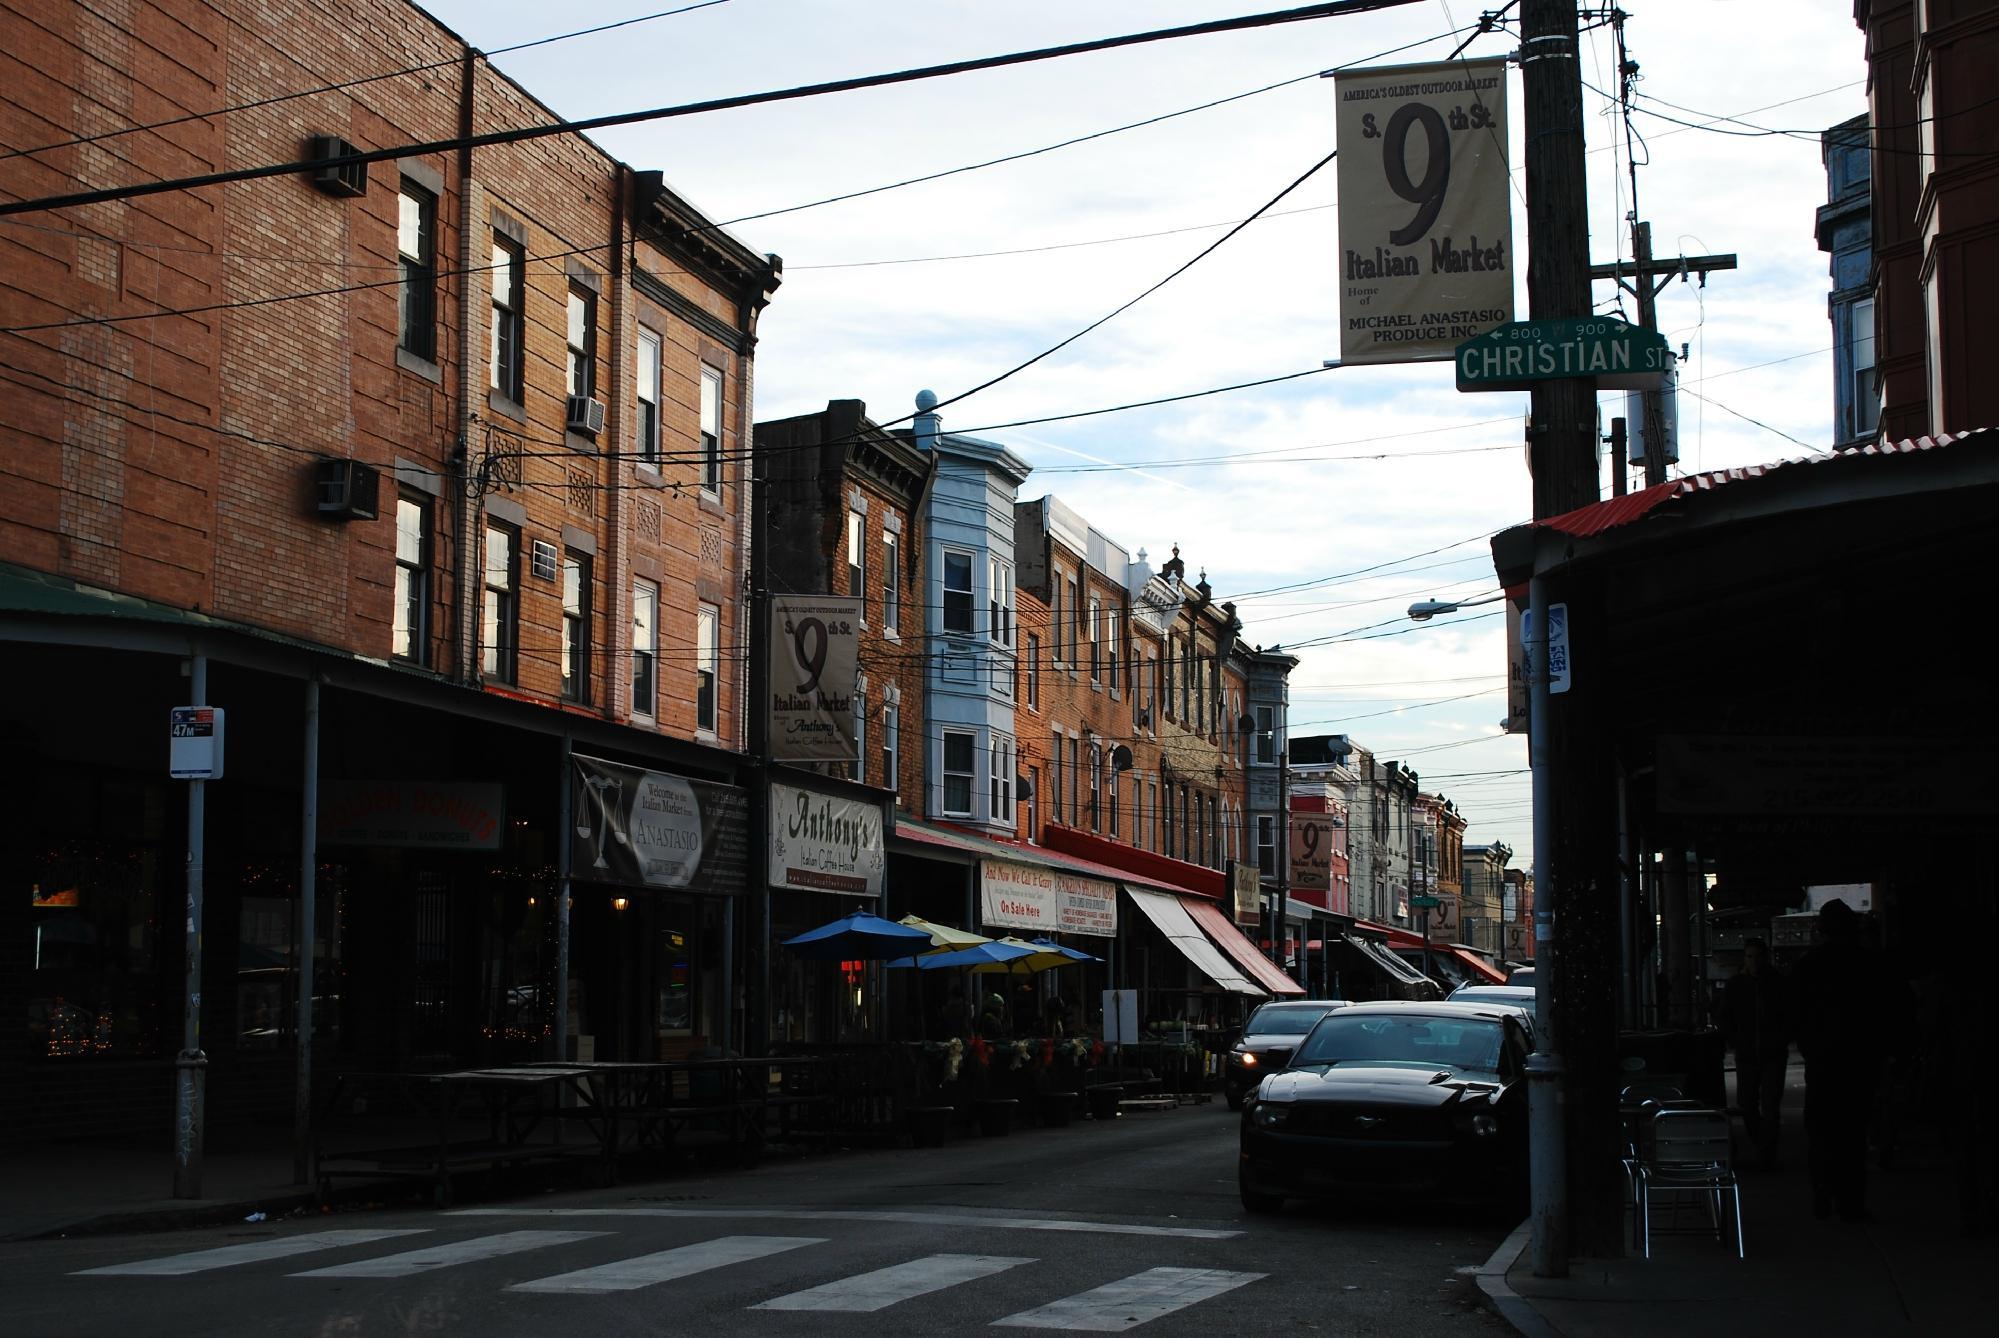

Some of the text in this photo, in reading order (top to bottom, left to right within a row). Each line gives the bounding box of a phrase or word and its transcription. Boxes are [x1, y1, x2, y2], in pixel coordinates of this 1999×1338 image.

[1343, 77, 1498, 101] AMERICA'S OLDEST OUTDOOR MARKET
[1362, 113, 1381, 138] S.
[1346, 235, 1505, 281] Italian Market
[1348, 287, 1379, 297] Home
[1359, 296, 1371, 306] of
[1348, 309, 1505, 330] MICHAEL ANASTASIO
[1373, 327, 1446, 342] PRODUCE
[1509, 324, 1606, 340] 800 900
[1461, 337, 1630, 379] CHRISTIAN
[774, 691, 850, 711] Italian Market
[173, 723, 194, 737] 47M
[647, 783, 674, 800] Welcome
[642, 795, 662, 812] Italian
[662, 799, 684, 816] Market
[789, 792, 868, 862] Anthony's
[801, 845, 855, 872] Italian Coffee House
[985, 866, 996, 880] And
[998, 867, 1010, 881] Now
[1011, 867, 1021, 883] We
[1021, 871, 1031, 886] Call
[1000, 900, 1040, 918] On Sale Here
